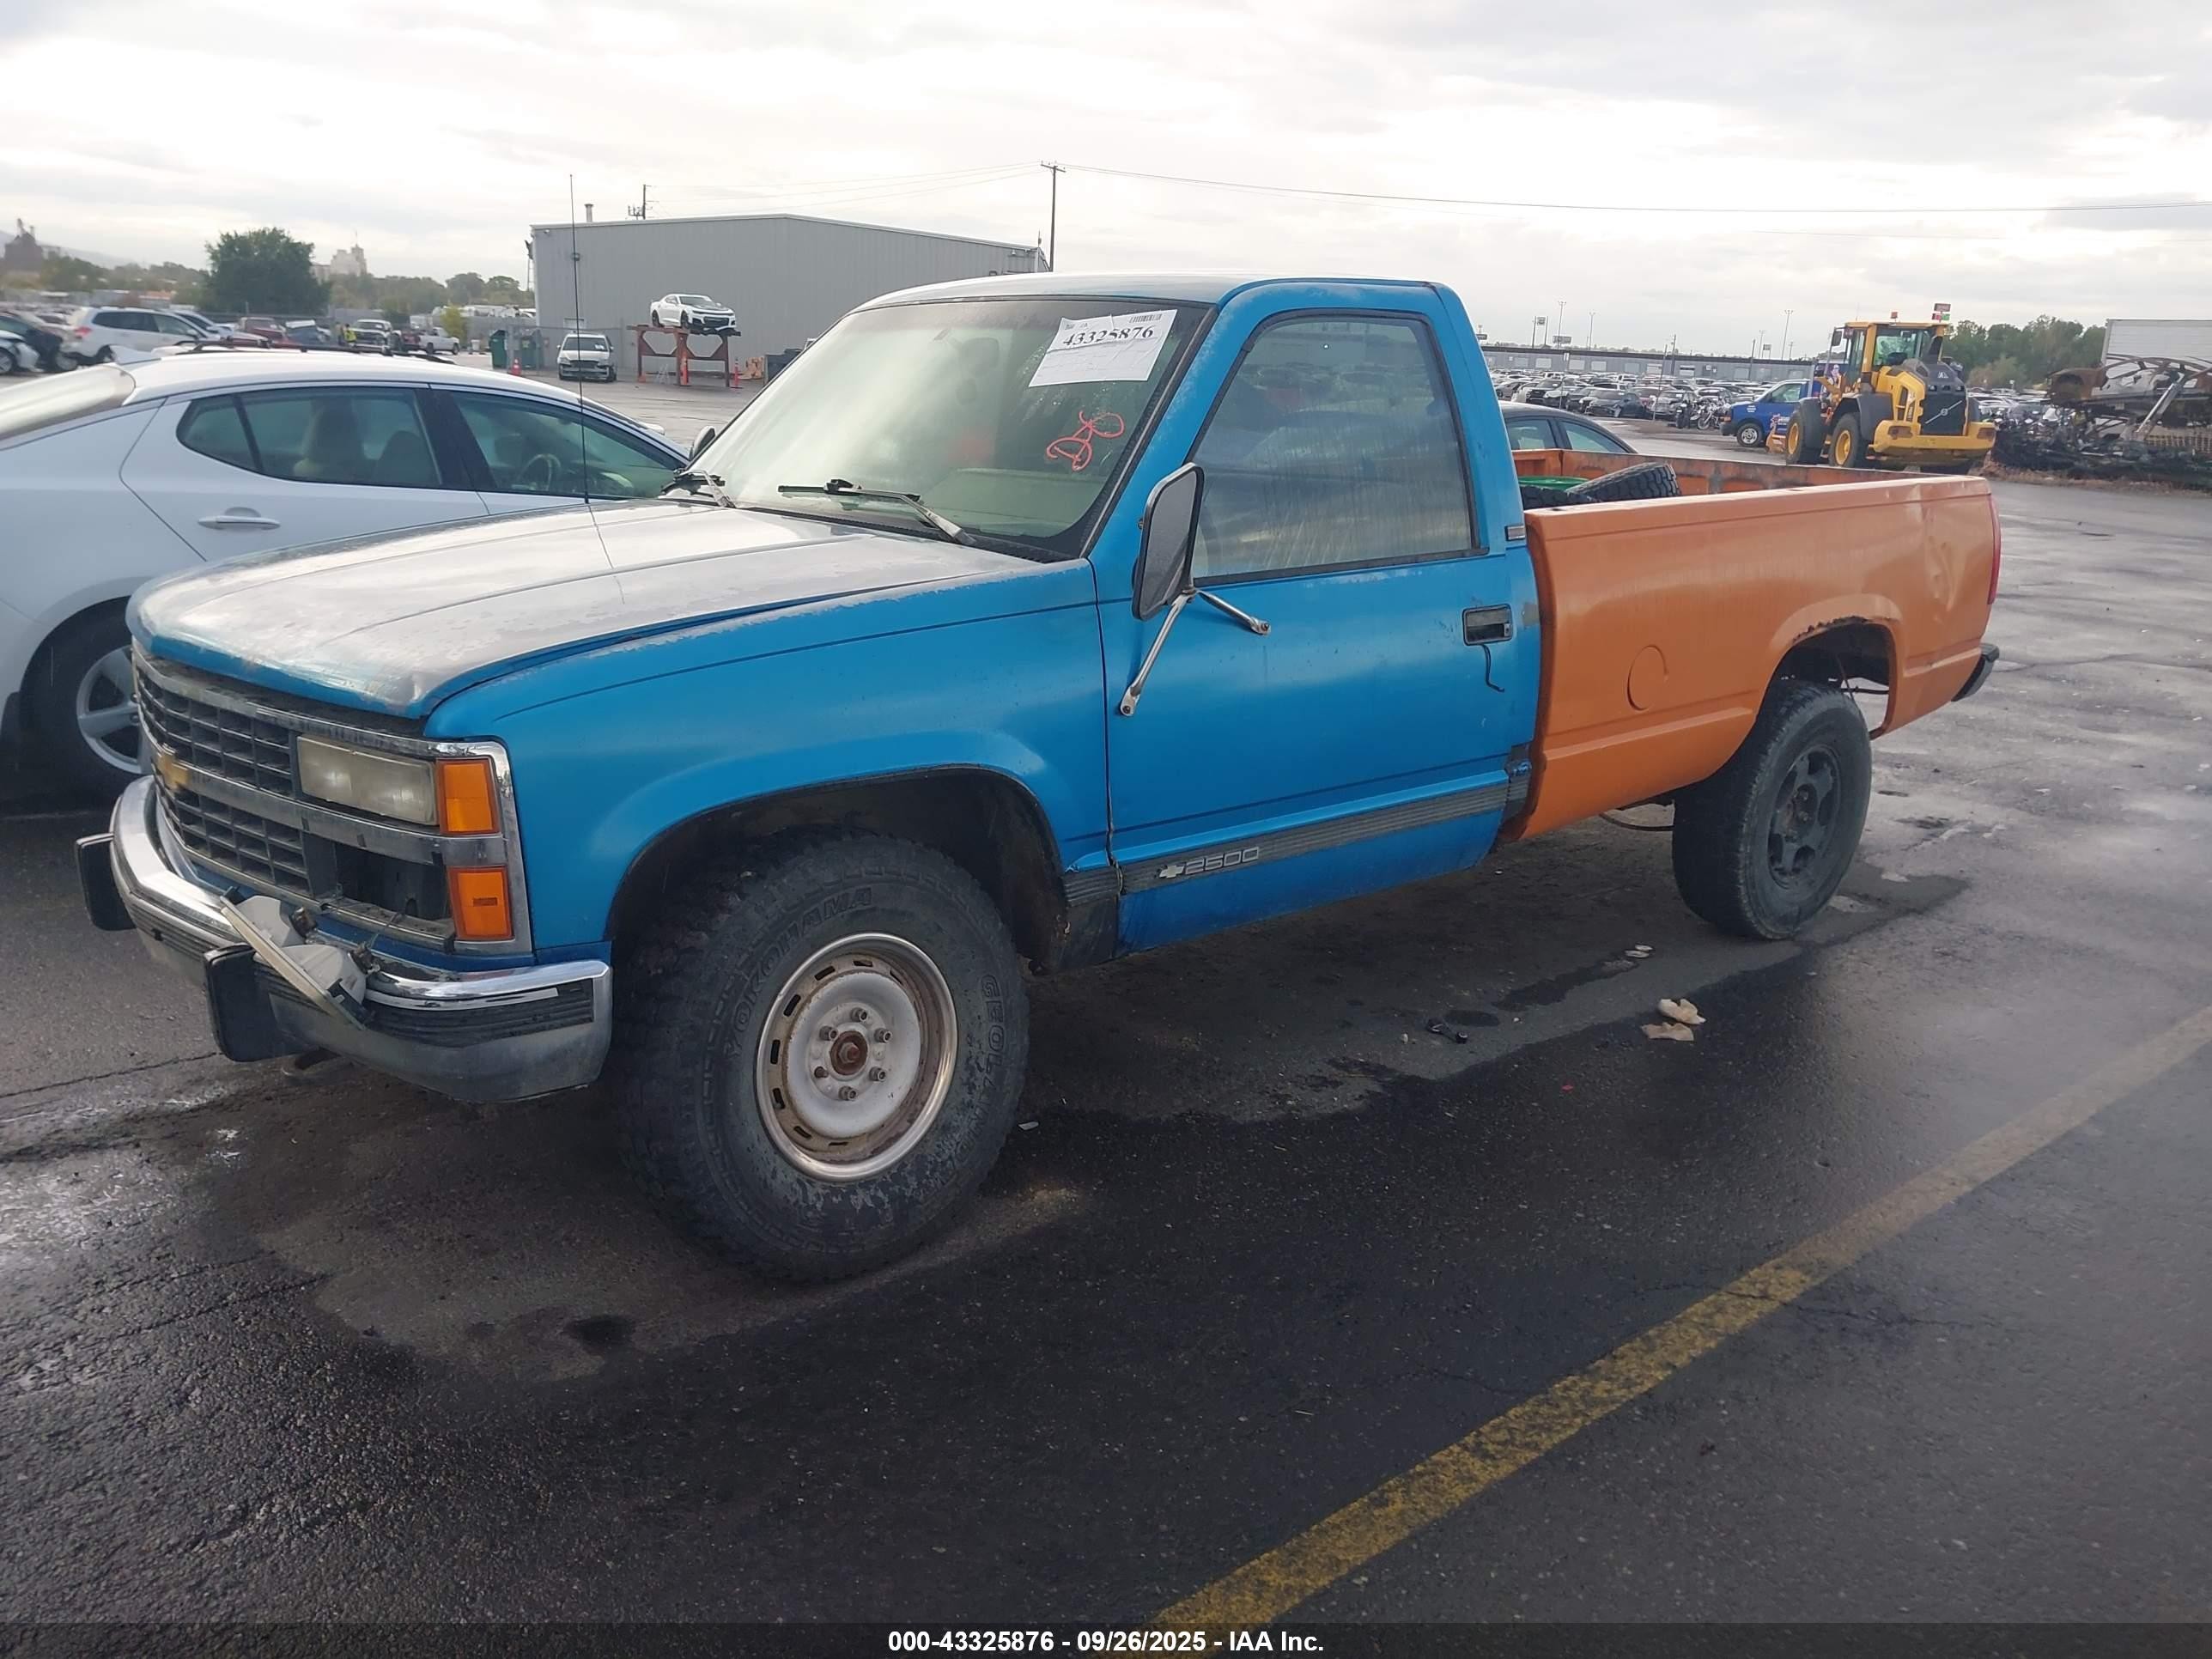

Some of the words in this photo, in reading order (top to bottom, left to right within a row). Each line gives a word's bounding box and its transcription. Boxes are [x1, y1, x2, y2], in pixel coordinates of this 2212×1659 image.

[1063, 325, 1155, 346] 43325876
[1185, 846, 1259, 875] 2500
[722, 886, 872, 1058] YOKOHAMA
